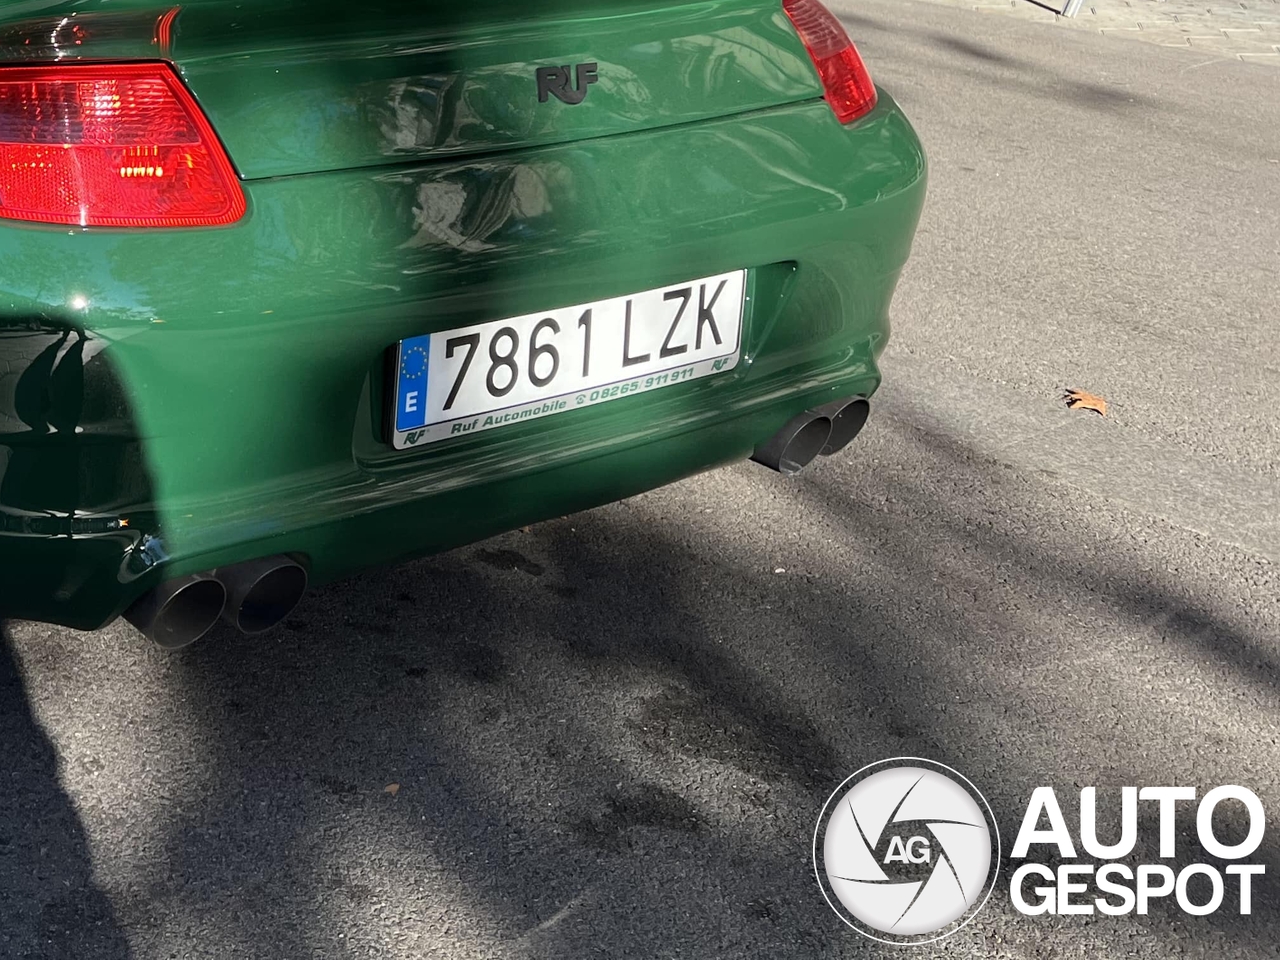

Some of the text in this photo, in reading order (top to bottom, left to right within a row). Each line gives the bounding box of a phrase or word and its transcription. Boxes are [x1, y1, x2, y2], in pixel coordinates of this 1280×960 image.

[536, 62, 599, 106] RUF
[442, 279, 728, 411] 7861 LZK
[404, 390, 419, 413] E
[450, 418, 480, 435] Ruf
[481, 399, 567, 427] Automobile
